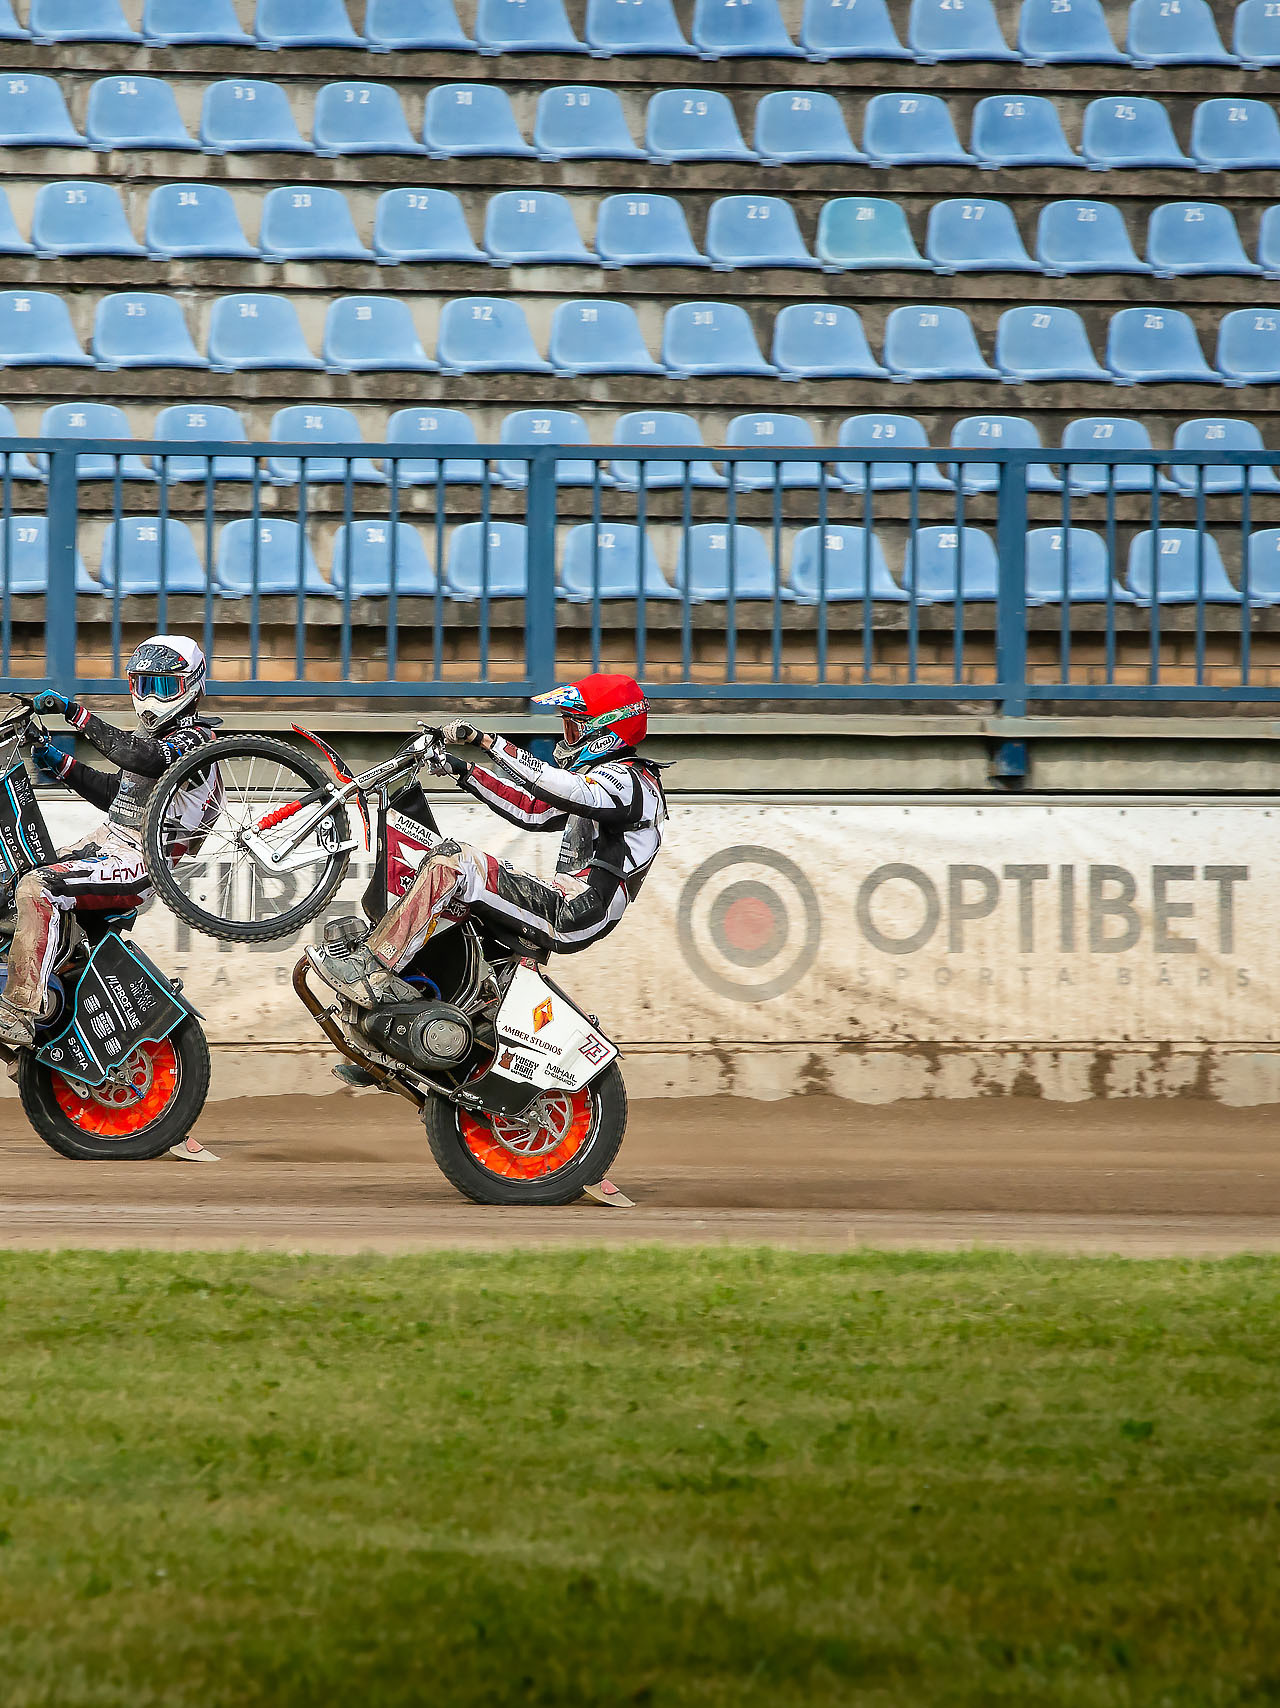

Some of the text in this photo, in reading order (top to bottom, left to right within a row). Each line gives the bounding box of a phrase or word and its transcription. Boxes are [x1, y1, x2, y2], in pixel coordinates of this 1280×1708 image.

[397, 815, 434, 843] MIHAIL
[856, 863, 1249, 954] OPTIBET
[115, 984, 141, 1029] PROFLINE
[502, 1025, 563, 1056] AMBER STUDIOS
[578, 1033, 610, 1066] 73
